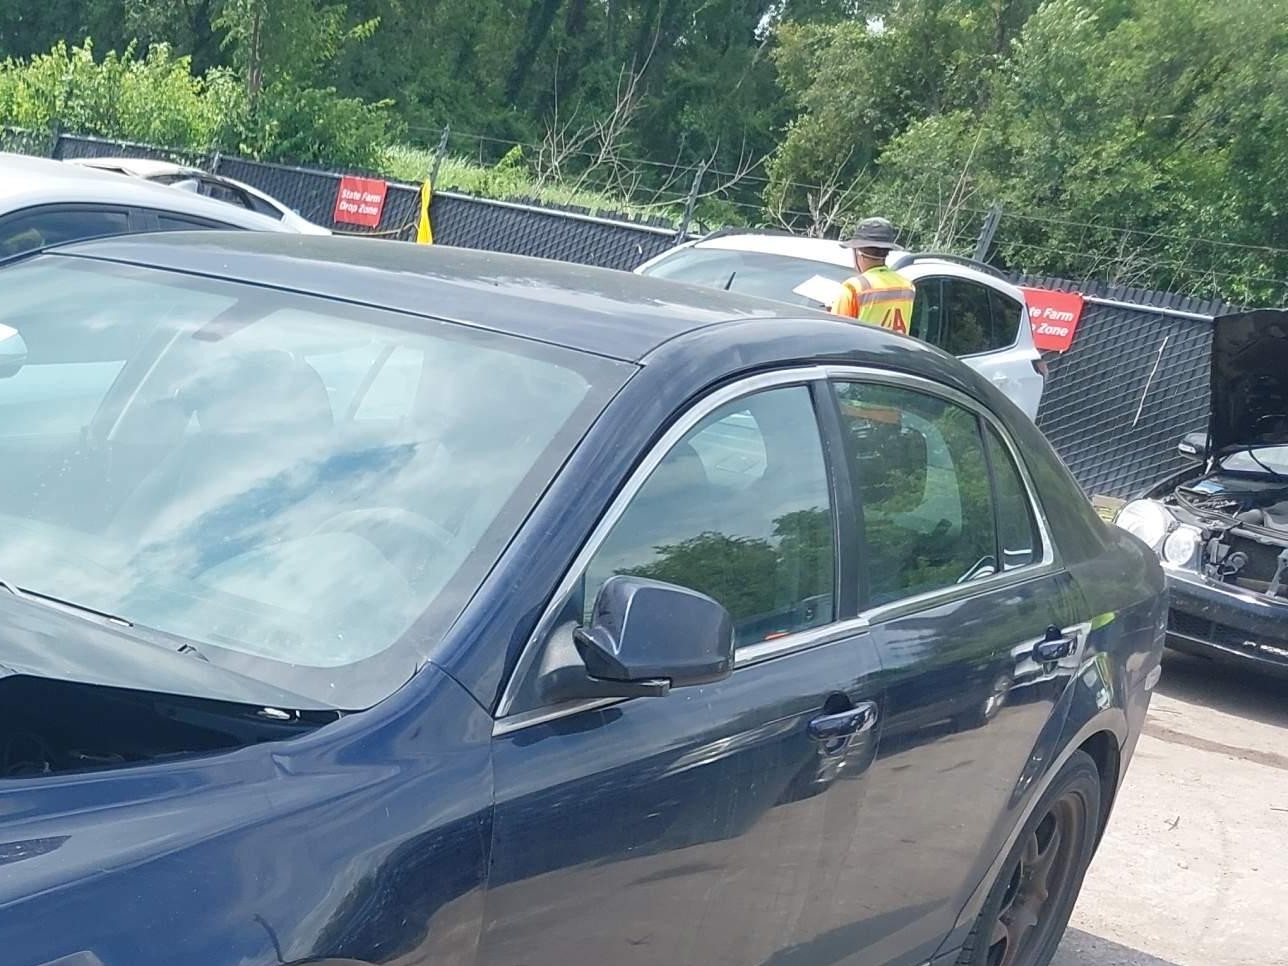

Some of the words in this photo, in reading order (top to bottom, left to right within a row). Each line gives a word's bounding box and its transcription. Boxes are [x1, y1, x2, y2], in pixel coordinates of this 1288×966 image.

[341, 188, 362, 201] State
[362, 191, 382, 203] Farm
[339, 200, 358, 214] Drop
[358, 203, 379, 216] Zone
[1043, 307, 1075, 322] Farm
[1036, 322, 1069, 337] Zone
